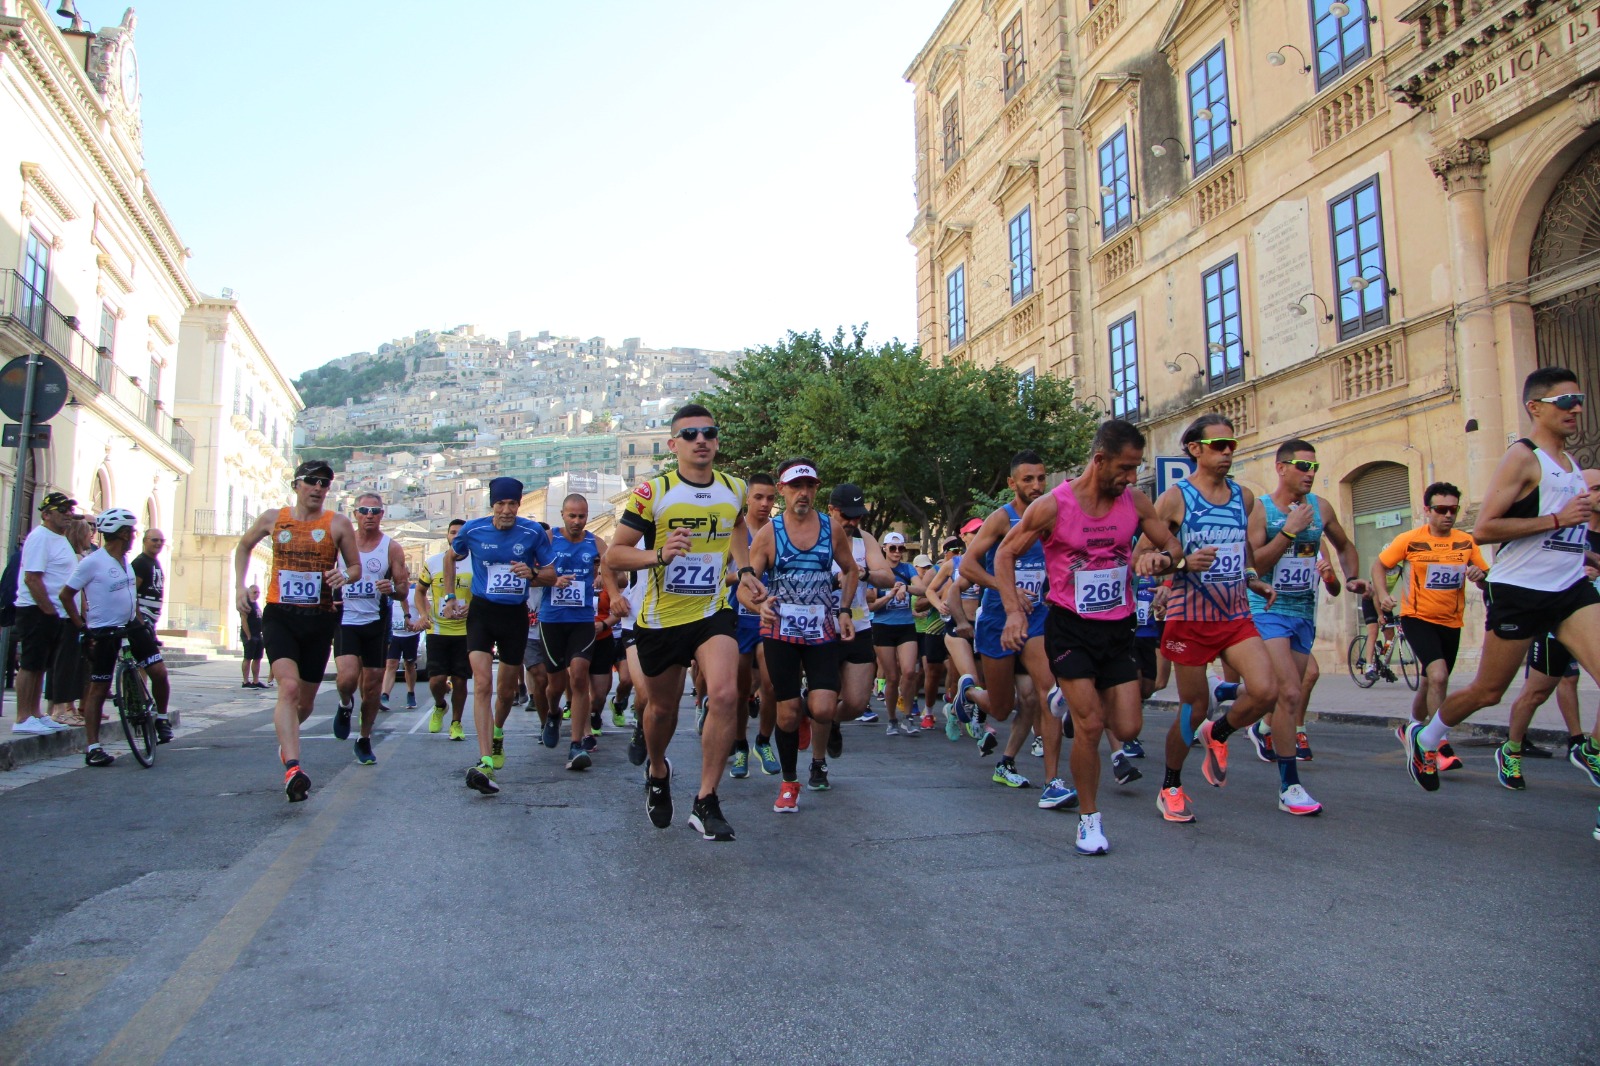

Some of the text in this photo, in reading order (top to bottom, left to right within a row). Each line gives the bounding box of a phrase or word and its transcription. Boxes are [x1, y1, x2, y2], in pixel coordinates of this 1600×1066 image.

[1451, 41, 1552, 113] PUBBLICA
[1164, 461, 1191, 490] P
[668, 517, 708, 530] CSF
[1082, 525, 1118, 533] GIVOVA
[1209, 554, 1242, 573] 292
[493, 573, 522, 588] 325
[671, 565, 715, 585] 274
[1279, 568, 1311, 584] 340
[1430, 571, 1460, 584] 284
[282, 580, 316, 597] 130
[347, 582, 374, 594] 318
[556, 588, 581, 601] 326
[1082, 580, 1122, 603] 268
[786, 614, 819, 631] 294
